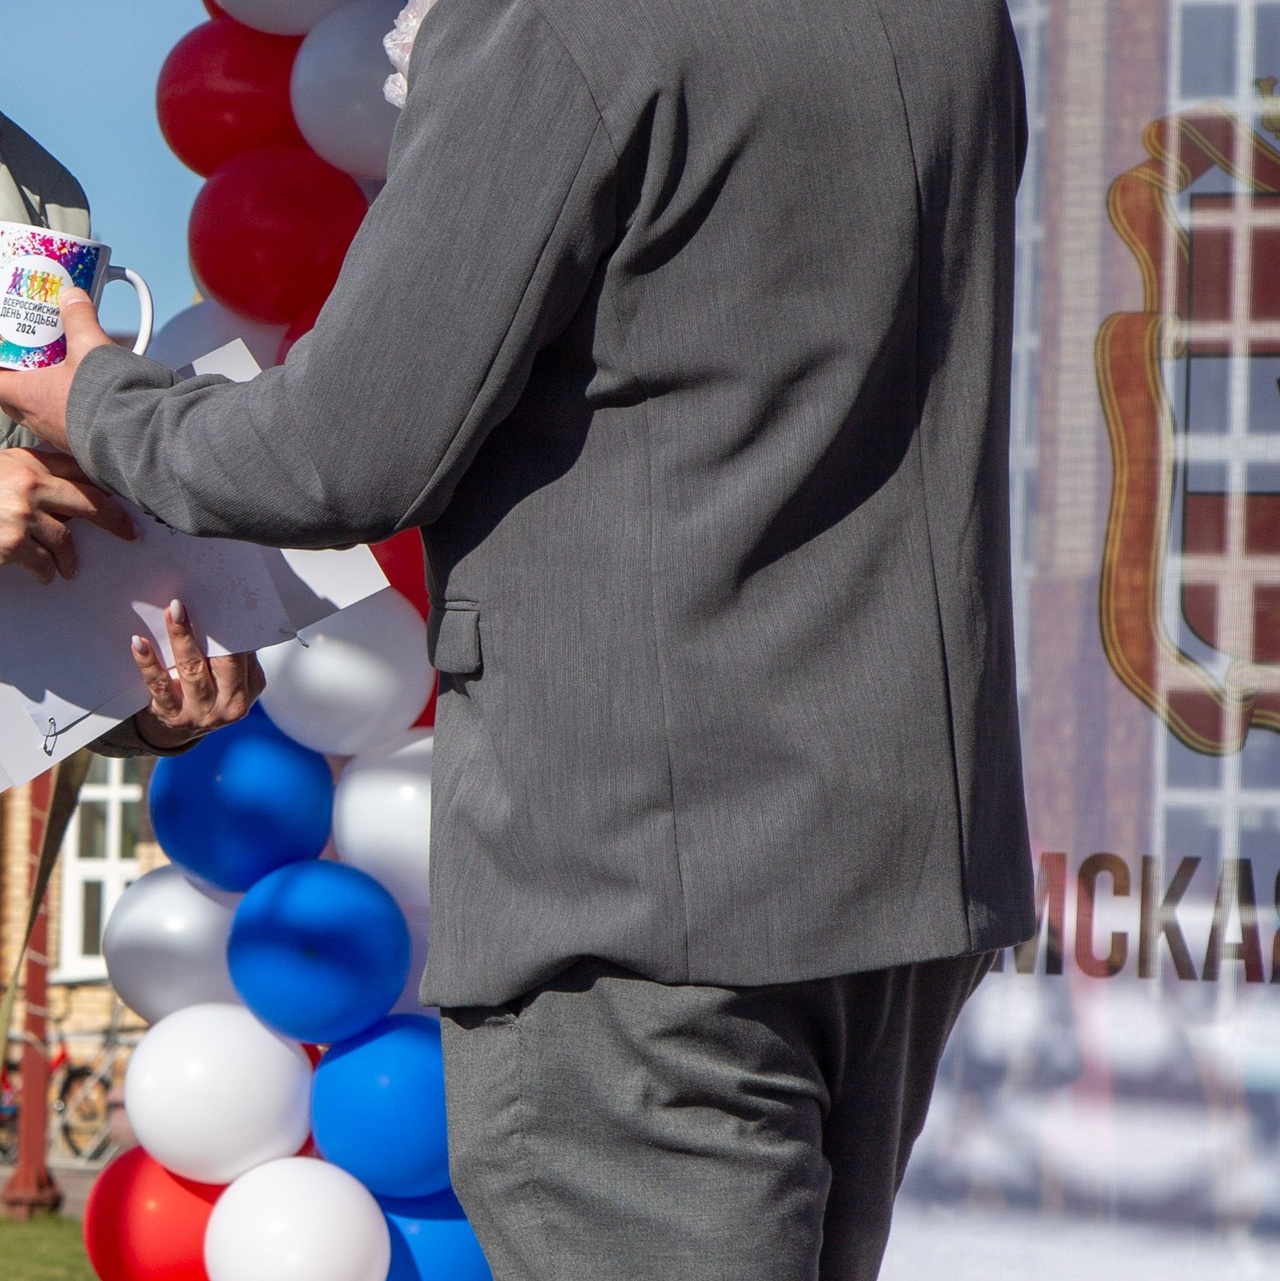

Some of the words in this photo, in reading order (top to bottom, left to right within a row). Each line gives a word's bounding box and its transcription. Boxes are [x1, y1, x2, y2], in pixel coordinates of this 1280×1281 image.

[0, 306, 21, 320] ДЕНЬ
[23, 310, 59, 328] ХОДЬБЫ
[3, 297, 61, 318] ВСЕРОССИЙСКИЙ
[15, 322, 37, 336] 2024
[990, 851, 1280, 983] МСКА
